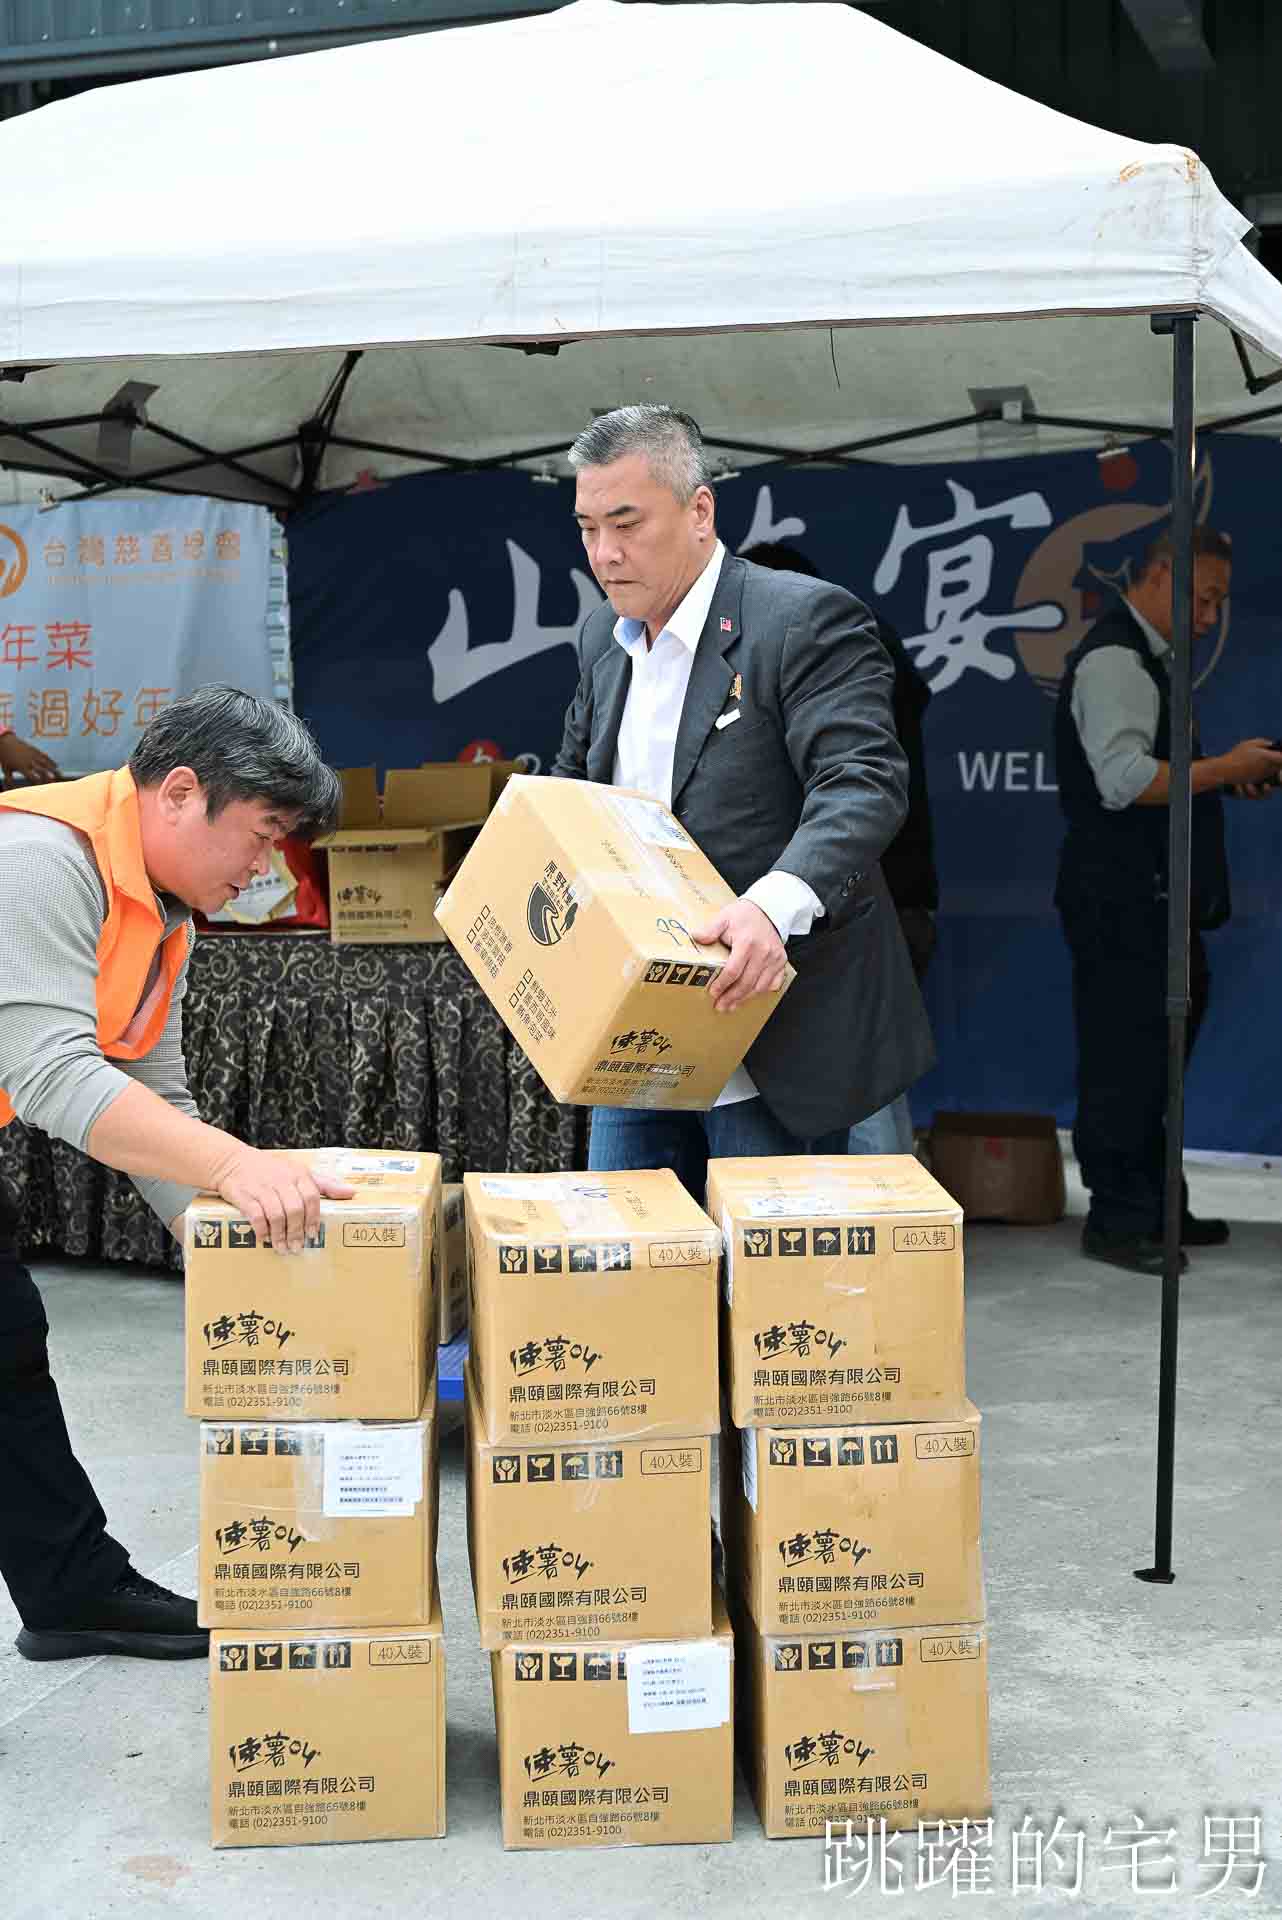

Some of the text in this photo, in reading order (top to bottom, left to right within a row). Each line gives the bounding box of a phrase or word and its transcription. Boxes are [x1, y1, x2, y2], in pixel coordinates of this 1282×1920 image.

[1, 621, 95, 672] 年菜
[352, 1228, 397, 1243] 40入裝
[903, 1231, 946, 1246] 40入裝
[658, 1246, 703, 1262] 40入裝
[202, 1359, 350, 1376] 鼎頤國際有限公司
[753, 1367, 901, 1387] 鼎頤國際有限公司
[509, 1378, 656, 1403] 鼎頤國際有限公司
[754, 1391, 892, 1405] 新北市淡水區自強路66號8樓
[203, 1397, 224, 1407] 電話
[754, 1404, 853, 1418] 電話 (02)2351-9100
[510, 1419, 608, 1434] 電話 (02)2351-9100
[924, 1436, 968, 1453] 40入裝
[650, 1454, 693, 1469] 40入裝
[215, 1562, 360, 1580] 鼎頤國際有限公司
[778, 1572, 925, 1593] 鼎頤國際有限公司
[215, 1600, 313, 1610] 電話 (02)2351-9100
[501, 1586, 648, 1610] 鼎頤國際有限公司
[778, 1596, 916, 1611] 新北市淡水區自強路66號8樓
[778, 1610, 878, 1624] 電話 (02)2351-9100
[502, 1627, 600, 1641] 電話 (02)2351-9100
[378, 1646, 424, 1661] 40入裝
[928, 1640, 974, 1656] 40入裝
[228, 1776, 376, 1798] 鼎頤國際有限公司
[784, 1773, 928, 1798] 鼎頤國際有限公司
[522, 1786, 670, 1808] 鼎頤國際有限公司
[228, 1815, 328, 1829] 電話 (02)2351-9100
[523, 1825, 622, 1838] 電話 (02)2351-9100
